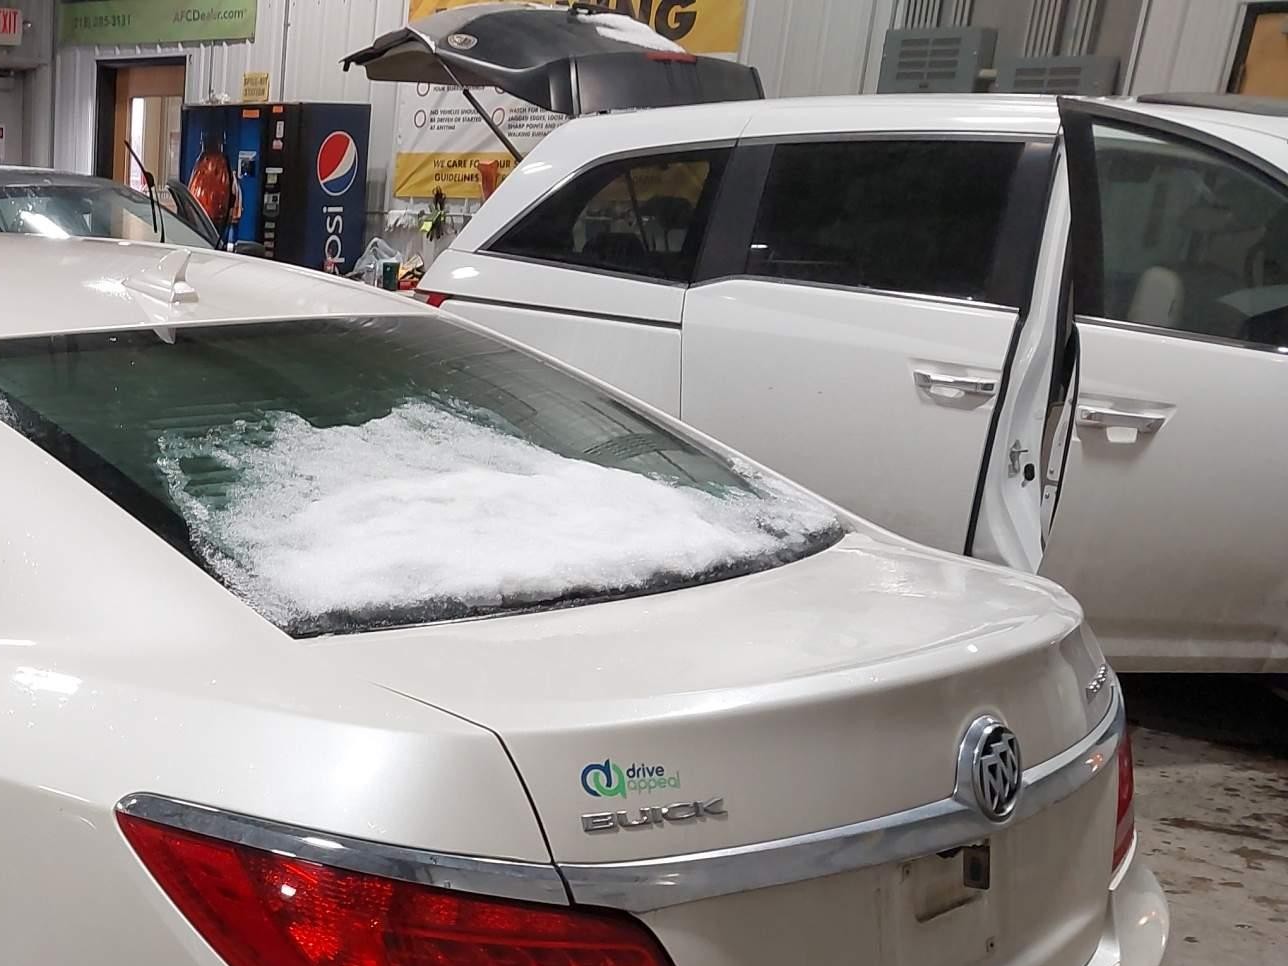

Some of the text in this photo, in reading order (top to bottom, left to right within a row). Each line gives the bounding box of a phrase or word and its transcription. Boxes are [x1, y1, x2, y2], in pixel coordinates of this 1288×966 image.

[433, 159, 444, 169] WE
[446, 159, 467, 169] CARE
[469, 159, 480, 169] FO
[435, 172, 480, 182] GUIDELINES
[626, 763, 665, 779] drive
[626, 771, 681, 795] appeal
[581, 798, 728, 833] BUICK
